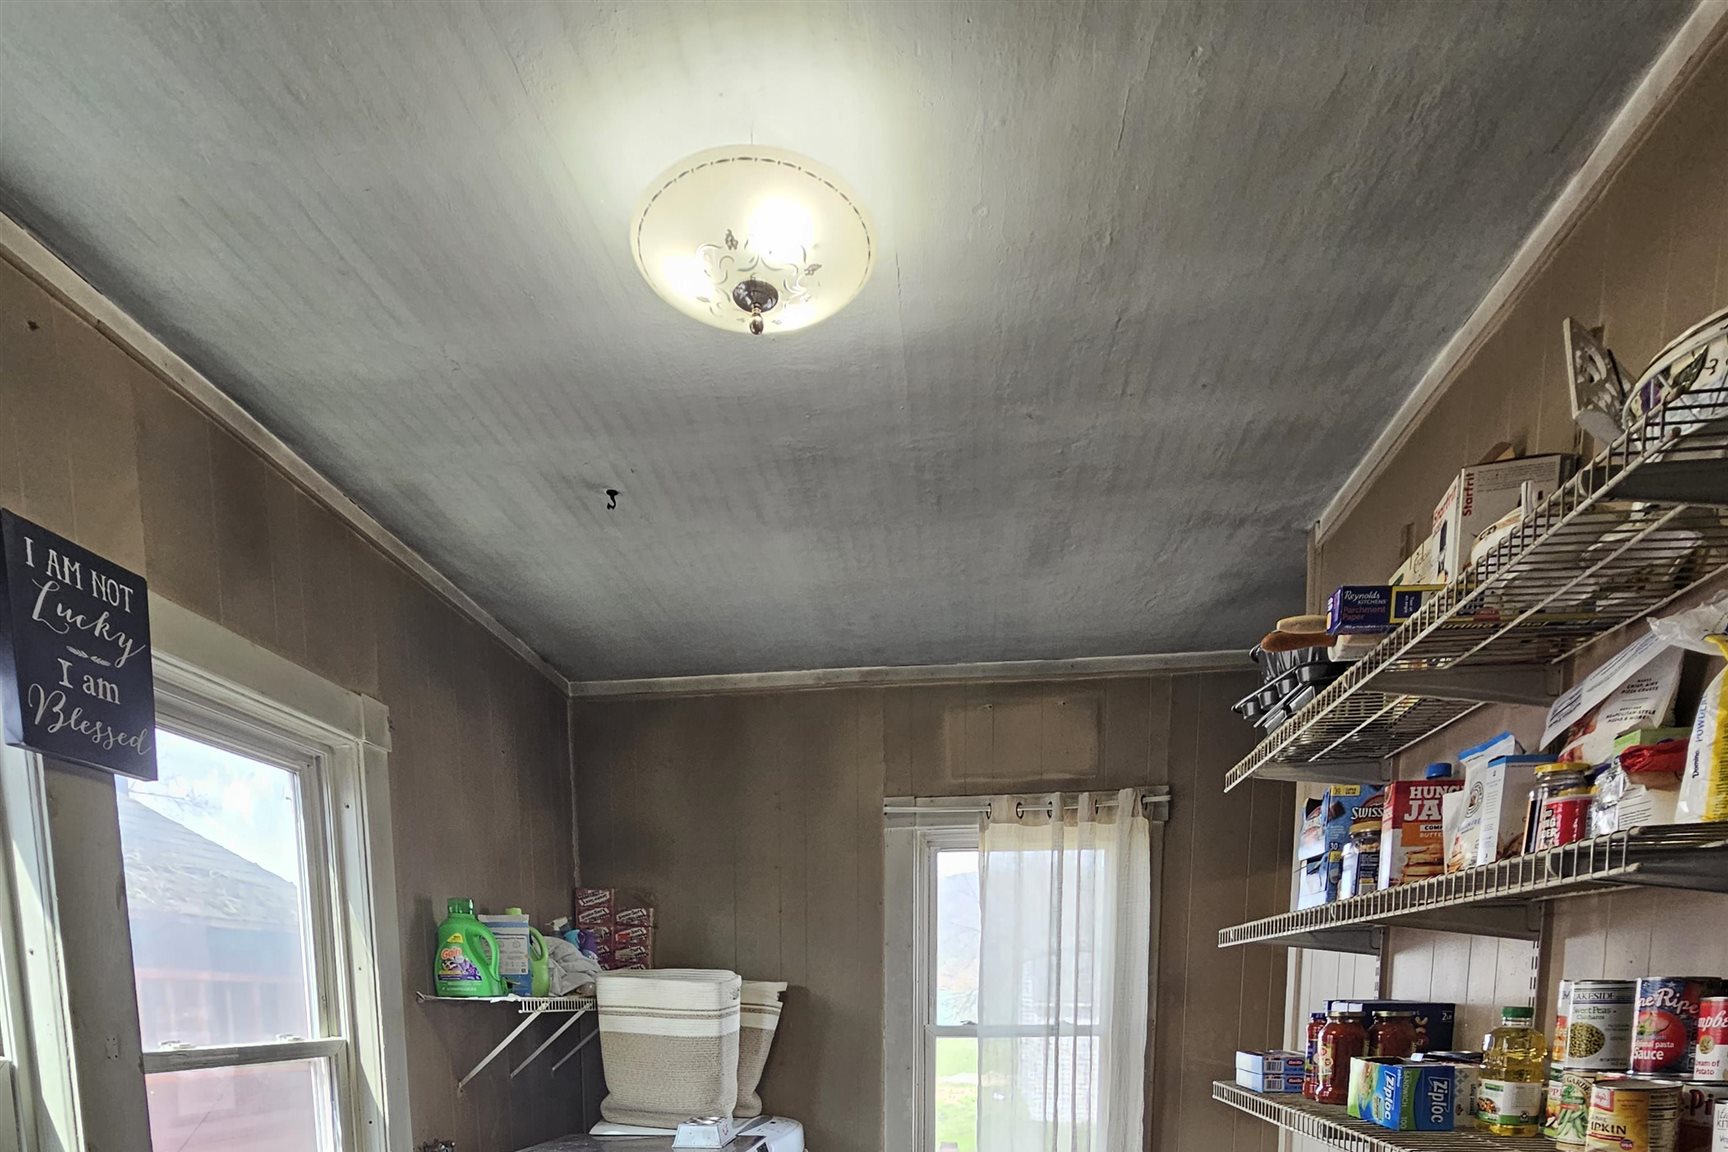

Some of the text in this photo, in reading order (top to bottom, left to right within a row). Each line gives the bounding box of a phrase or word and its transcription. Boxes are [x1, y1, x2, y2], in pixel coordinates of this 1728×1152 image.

[1462, 472, 1475, 518] Starfrit
[24, 536, 134, 613] I AM NOT
[1343, 606, 1386, 614] Parchment
[1344, 590, 1380, 601] Reynolds
[32, 577, 146, 668] Lucky
[1343, 613, 1366, 621] Paper
[57, 658, 120, 705] I am
[28, 683, 152, 755] Blessed
[1593, 1006, 1612, 1014] Peas
[1655, 987, 1699, 1014] Ripe
[1634, 1048, 1664, 1060] Sauce
[1384, 1074, 1395, 1120] Ziploc
[1402, 1070, 1411, 1107] SANDWICH
[1428, 1080, 1448, 1123] Ziploc
[1591, 1121, 1627, 1135] PKIN
